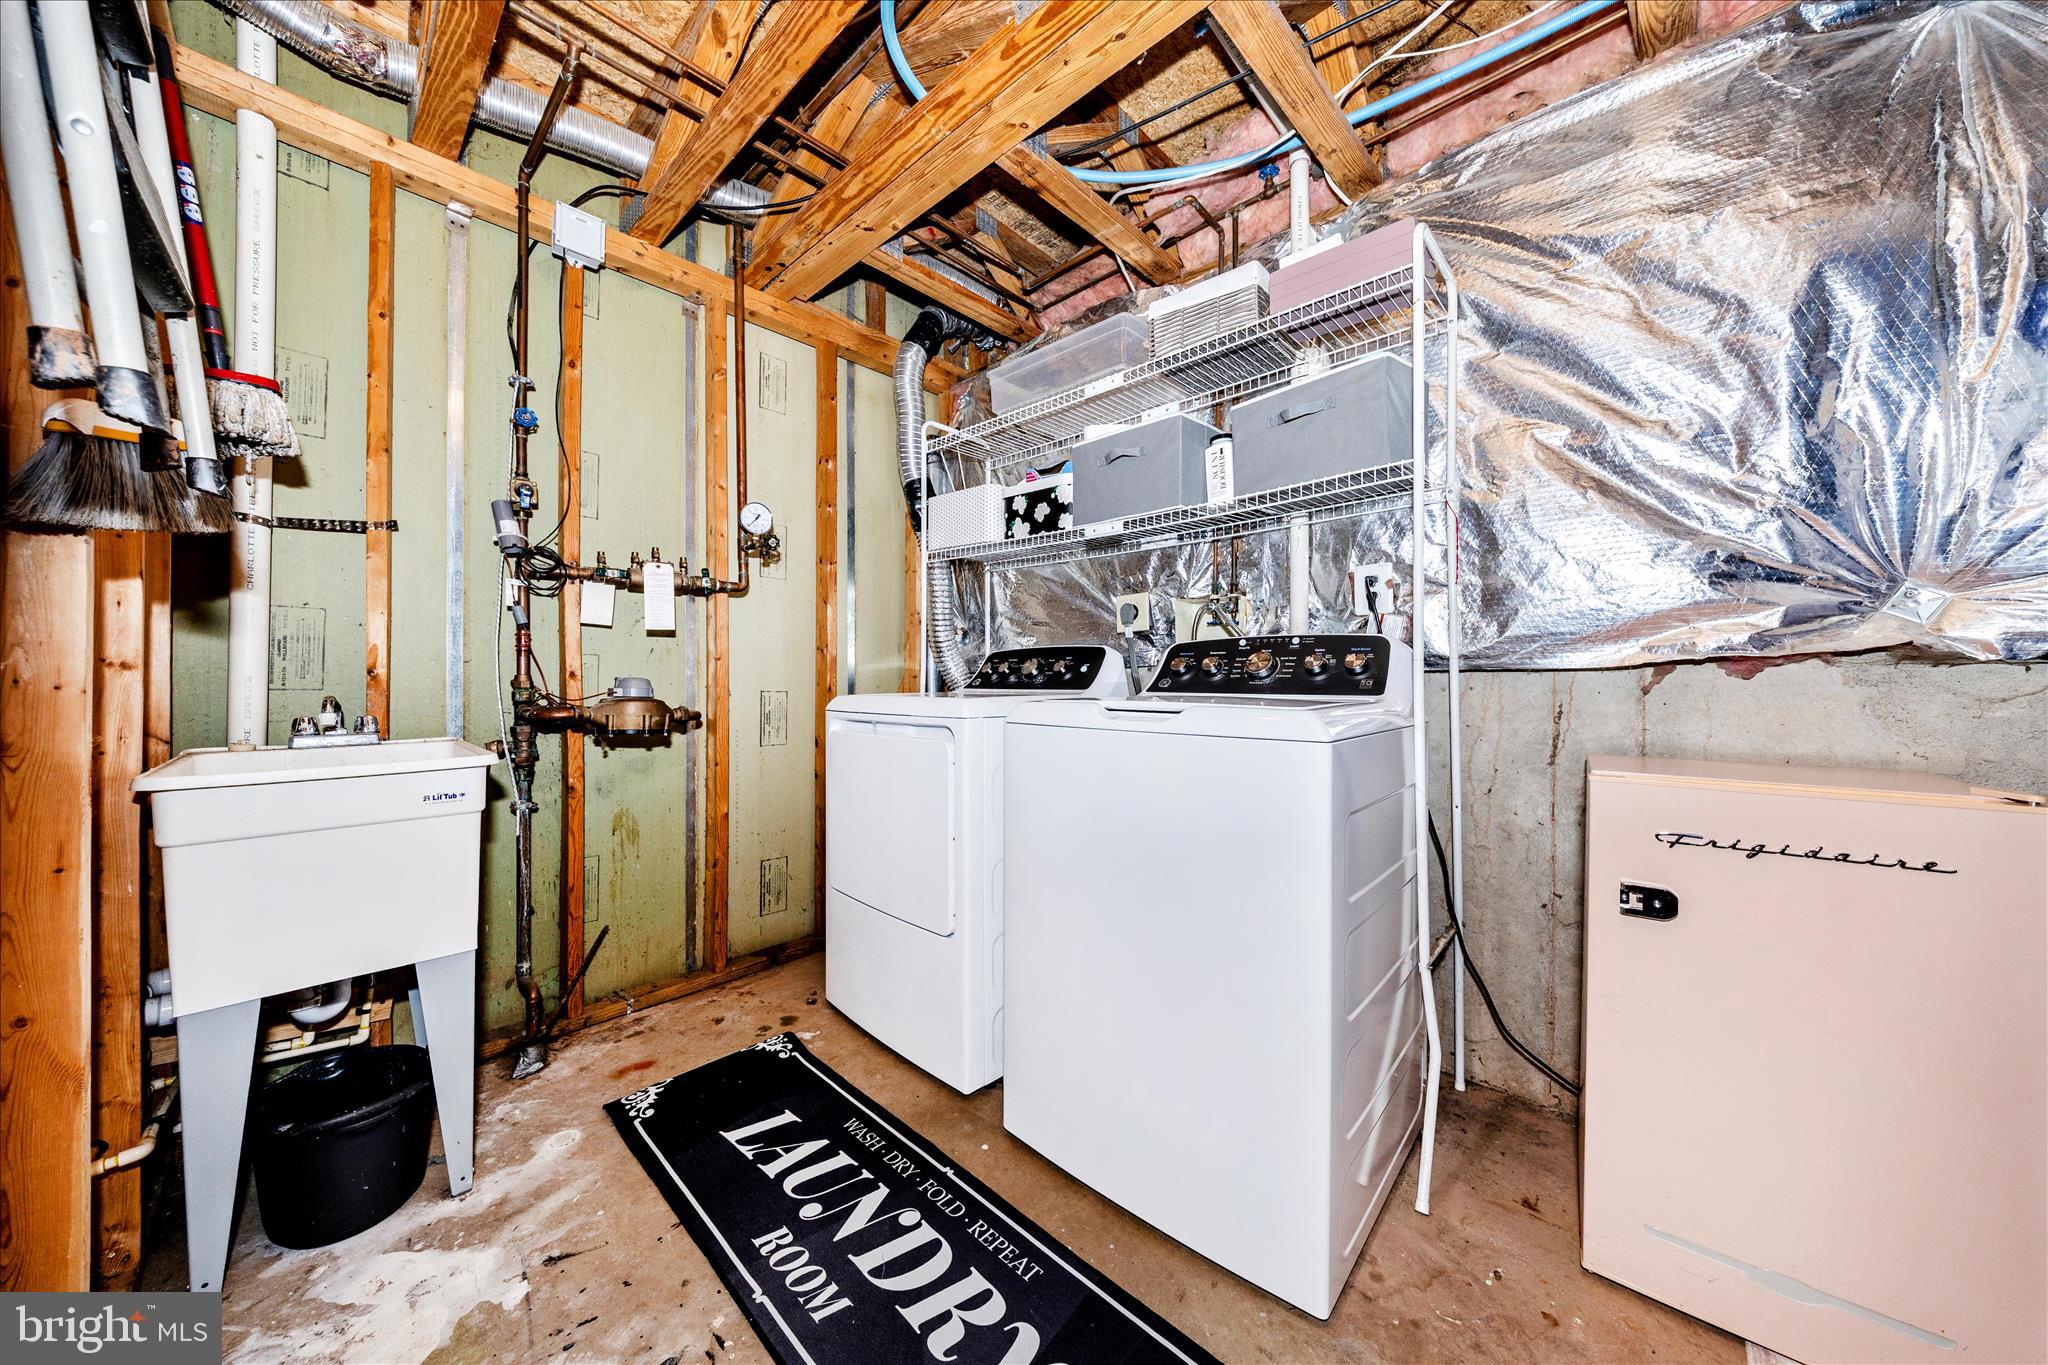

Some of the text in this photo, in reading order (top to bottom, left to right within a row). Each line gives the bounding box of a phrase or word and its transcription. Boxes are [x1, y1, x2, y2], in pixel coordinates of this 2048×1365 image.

[252, 240, 261, 295] PRESSURE
[251, 302, 259, 323] FOR
[251, 330, 259, 352] NOT
[246, 529, 256, 591] CHARLOTTE
[1655, 832, 1957, 874] Frigidaire
[842, 1117, 1044, 1283] WASH DRY FOLD REPEAT
[751, 1225, 854, 1325] ROOM
